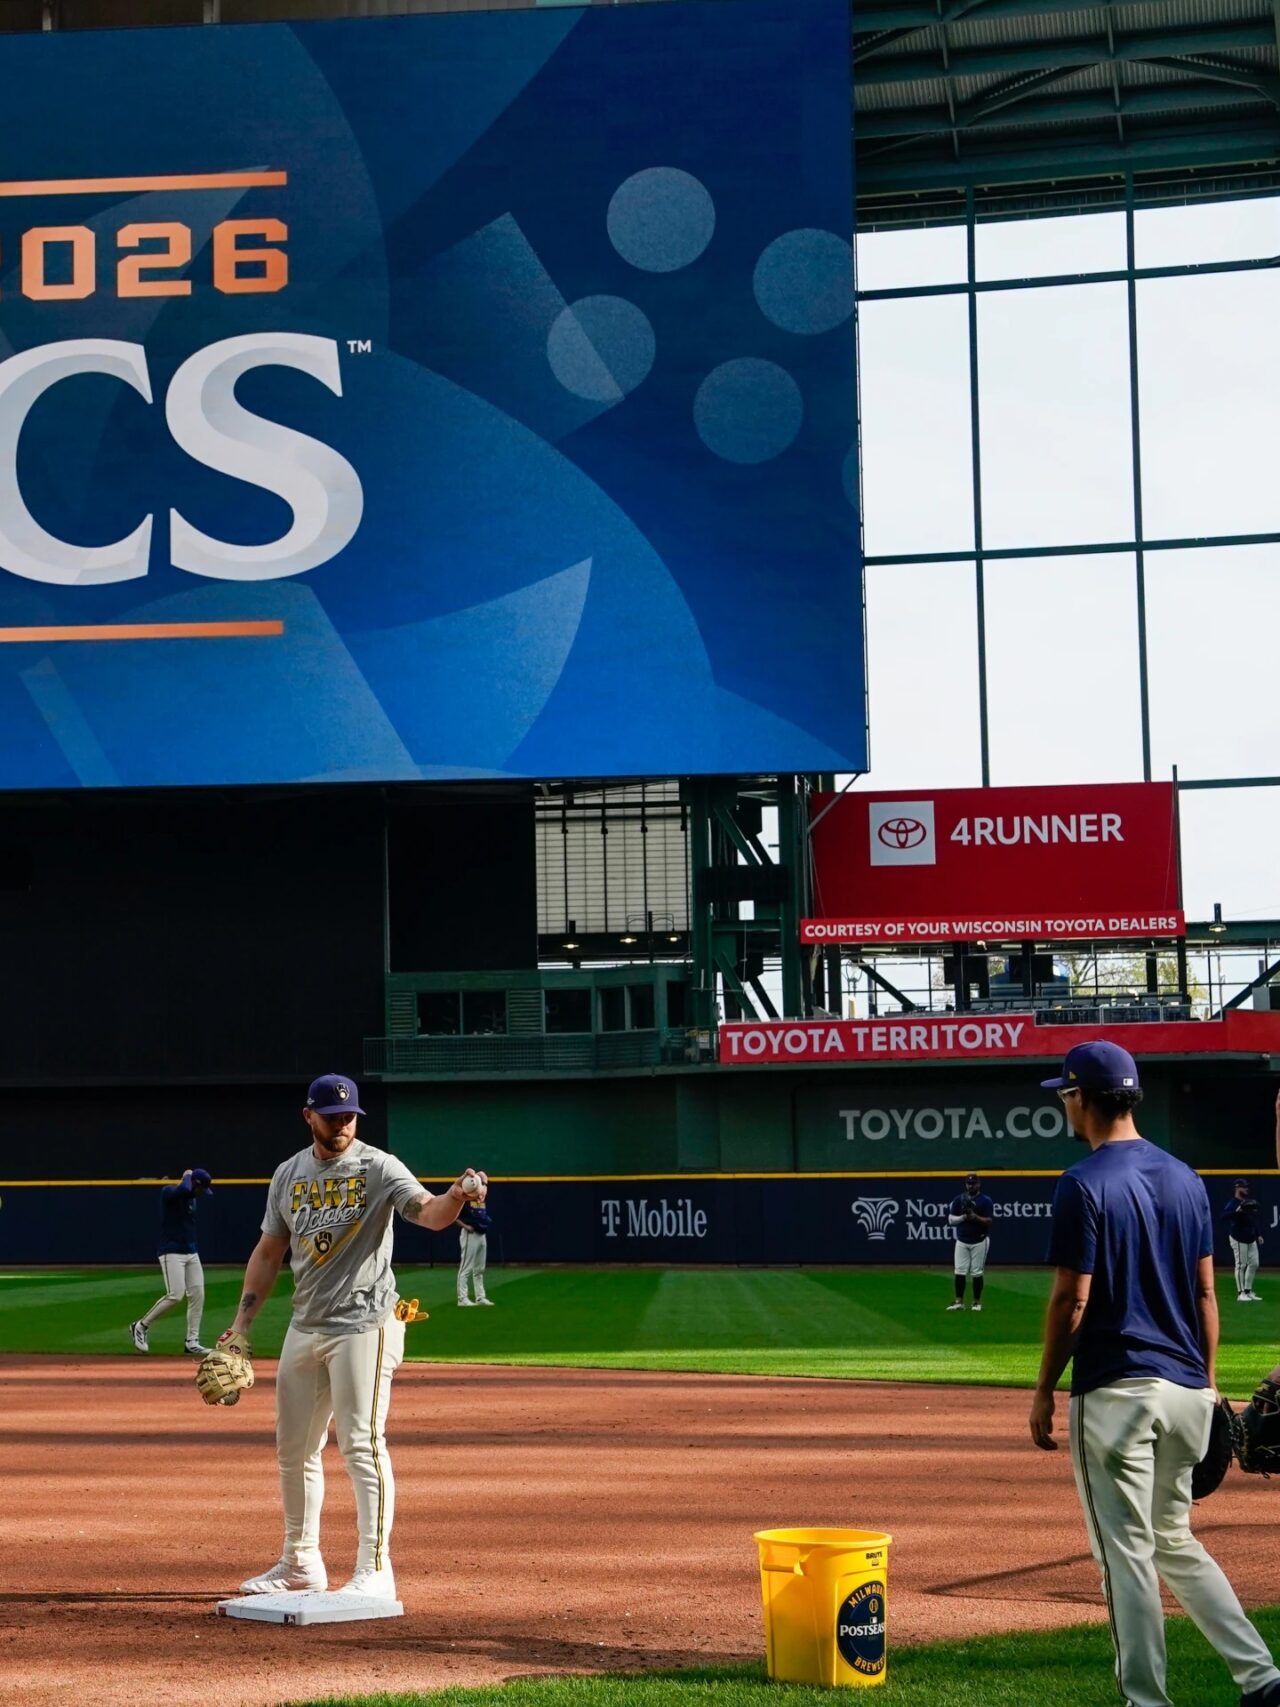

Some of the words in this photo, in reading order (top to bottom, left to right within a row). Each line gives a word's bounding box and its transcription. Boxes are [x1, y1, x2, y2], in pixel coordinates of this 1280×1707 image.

[950, 812, 1125, 847] 4RUNNER
[804, 923, 881, 938] COURTESY
[884, 922, 905, 935] OF
[907, 921, 950, 935] YOUR
[952, 919, 1042, 934] WISCONSIN
[1045, 918, 1106, 932] TOYOTA
[1109, 916, 1177, 931] DEALERS
[726, 1028, 845, 1056] TOYOTA
[852, 1022, 1024, 1052] TERRITORY
[290, 1176, 368, 1214] TAKE
[293, 1200, 366, 1236] October
[839, 1622, 885, 1637] POSTSEAS
